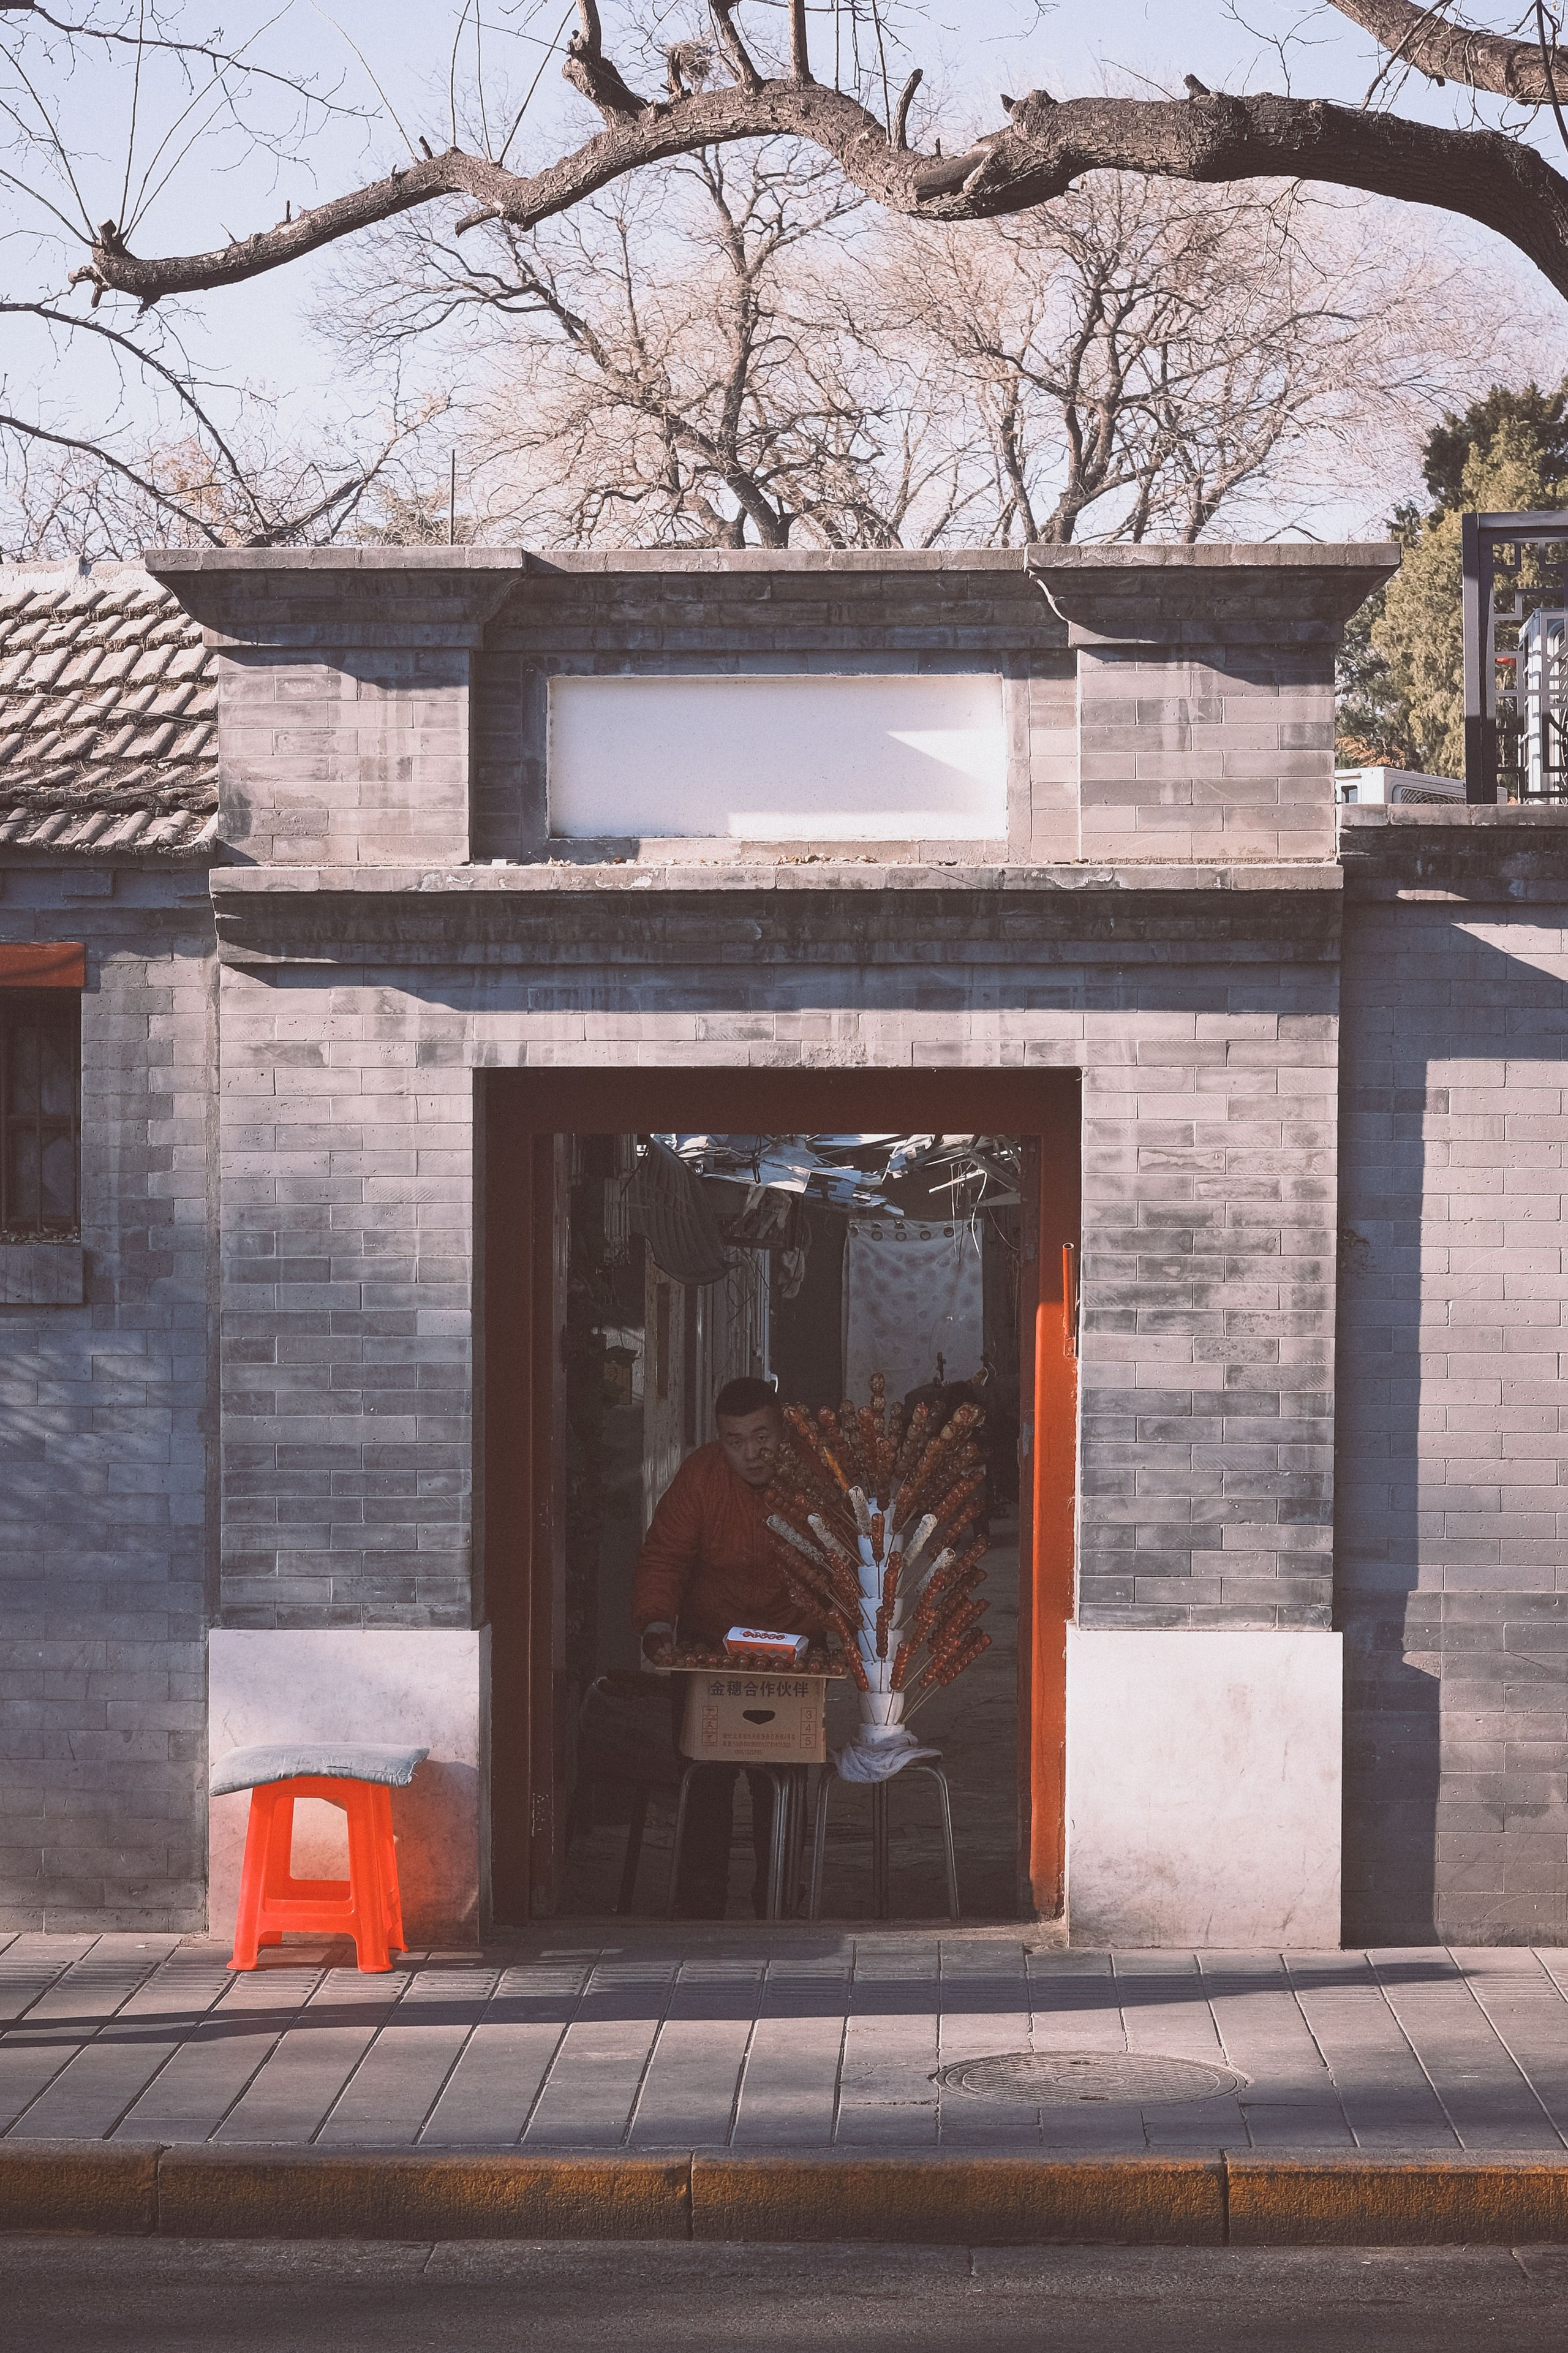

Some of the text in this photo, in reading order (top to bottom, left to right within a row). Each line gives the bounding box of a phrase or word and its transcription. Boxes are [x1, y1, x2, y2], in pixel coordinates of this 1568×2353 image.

[710, 1680, 809, 1697] 金穗合作伙伴
[805, 1710, 812, 1720] 3
[805, 1724, 811, 1732] 4
[805, 1737, 811, 1745] 5
